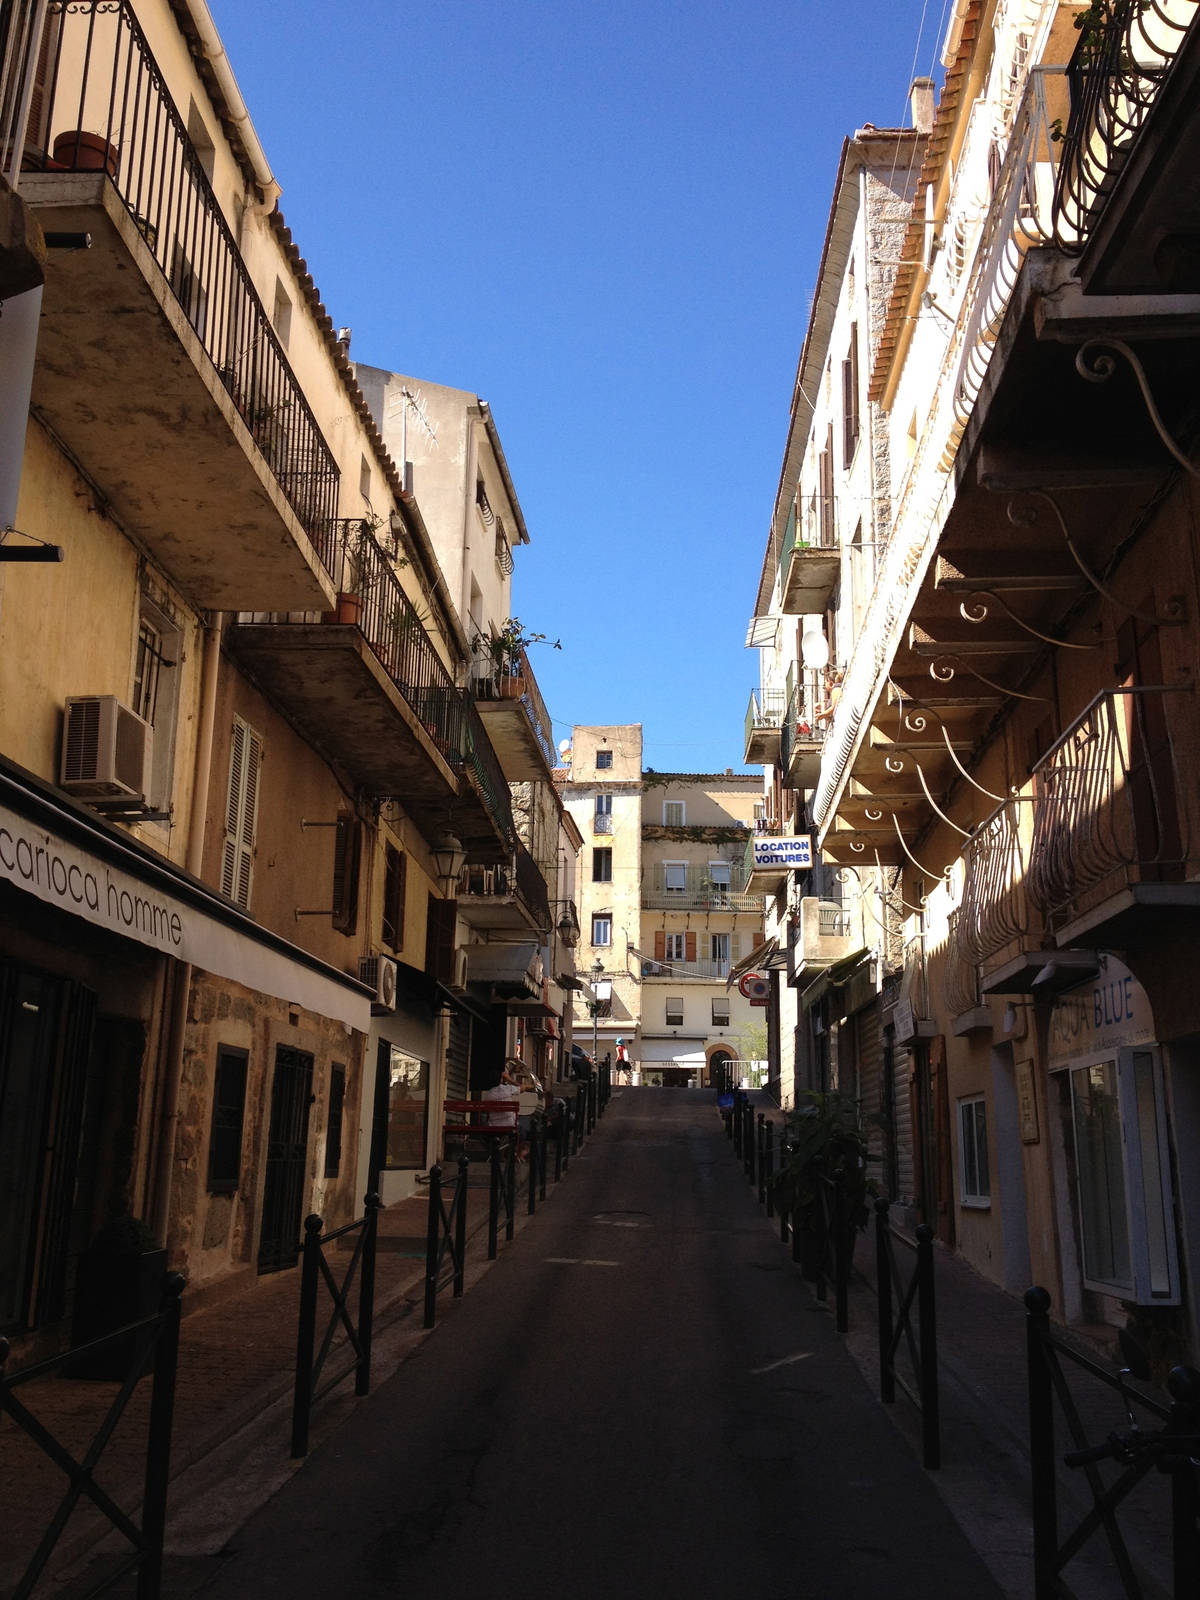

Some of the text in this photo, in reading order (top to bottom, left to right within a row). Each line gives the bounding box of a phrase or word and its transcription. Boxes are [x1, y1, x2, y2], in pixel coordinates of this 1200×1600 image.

[755, 842, 809, 851] LOCATION
[755, 854, 810, 863] VOITURES
[0, 828, 181, 945] carioca homme
[1053, 976, 1134, 1044] AQUA BLUE
